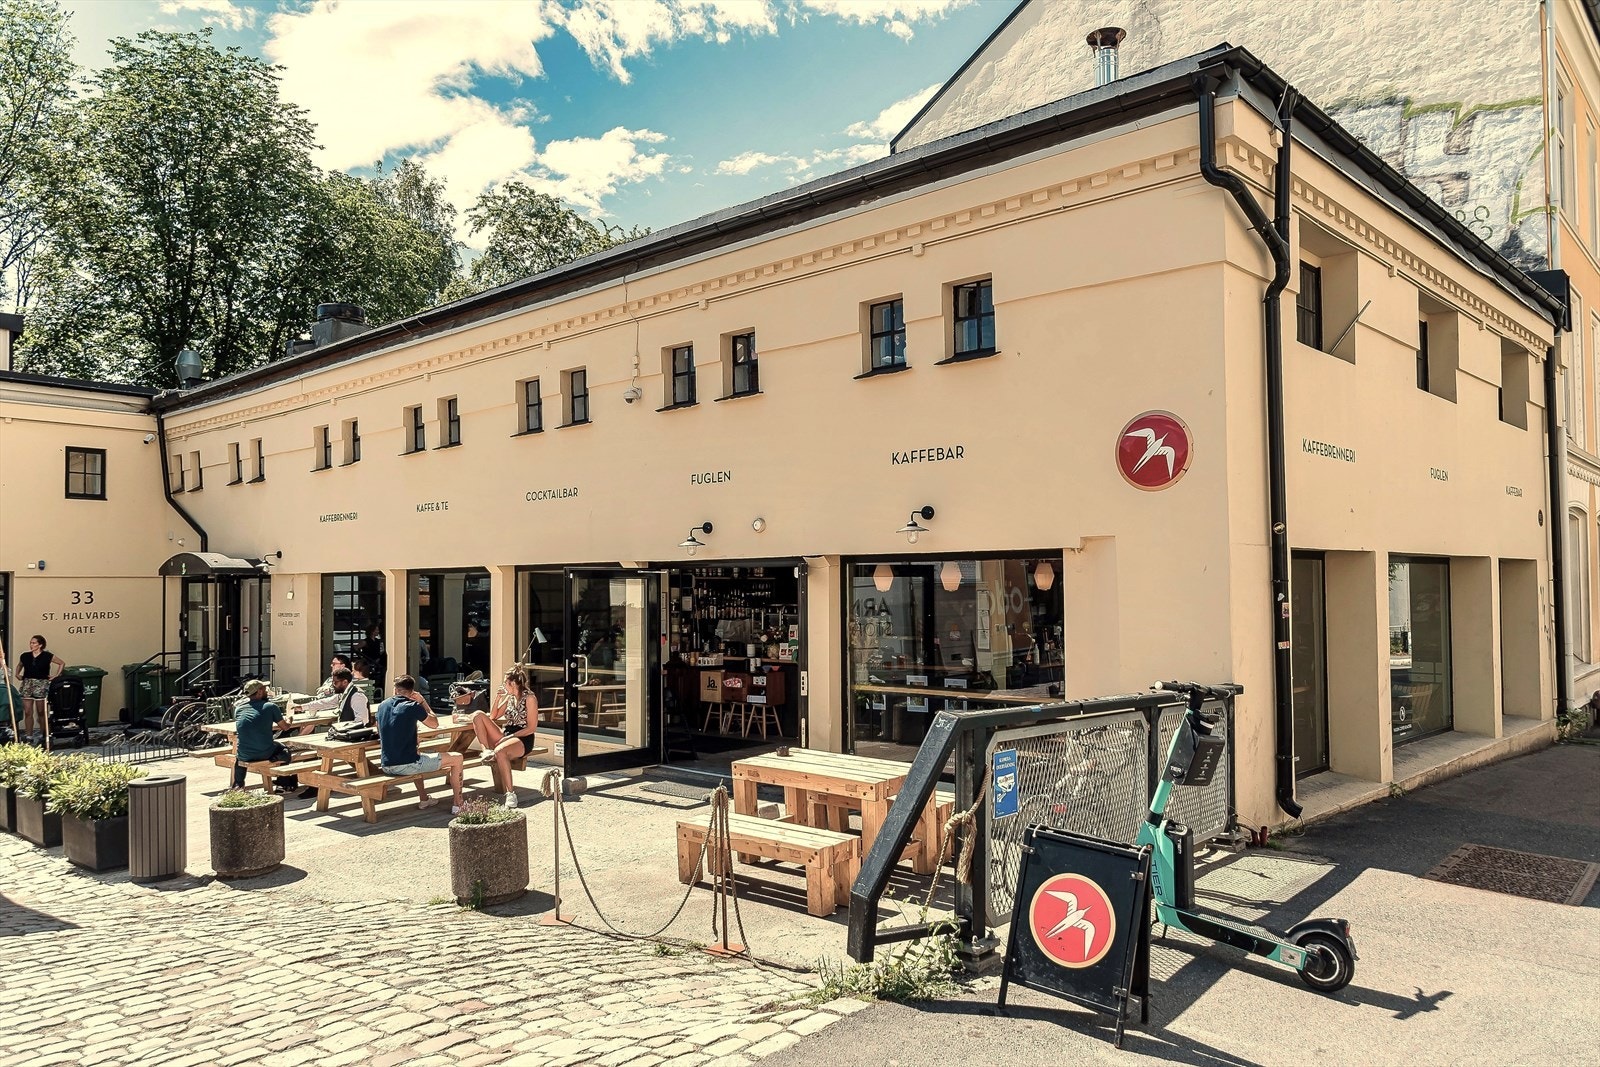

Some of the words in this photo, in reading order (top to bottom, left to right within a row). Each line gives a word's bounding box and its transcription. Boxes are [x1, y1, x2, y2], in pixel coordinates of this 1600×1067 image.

[891, 445, 965, 466] KAFFEBAR
[1302, 437, 1356, 463] KAFFEBRENNERI
[691, 470, 732, 486] FUGLEN
[1430, 467, 1449, 482] FUGLEN
[525, 486, 579, 502] COCKTAILBAR
[416, 503, 434, 513] KAFFE
[436, 502, 440, 511] &
[441, 501, 448, 511] TE
[319, 511, 358, 523] KAFFEBRENNERI
[71, 590, 94, 609] 33
[42, 613, 59, 621] ST.
[63, 611, 120, 620] HALVARDS
[67, 625, 96, 635] GATE
[1151, 859, 1163, 896] TIER
